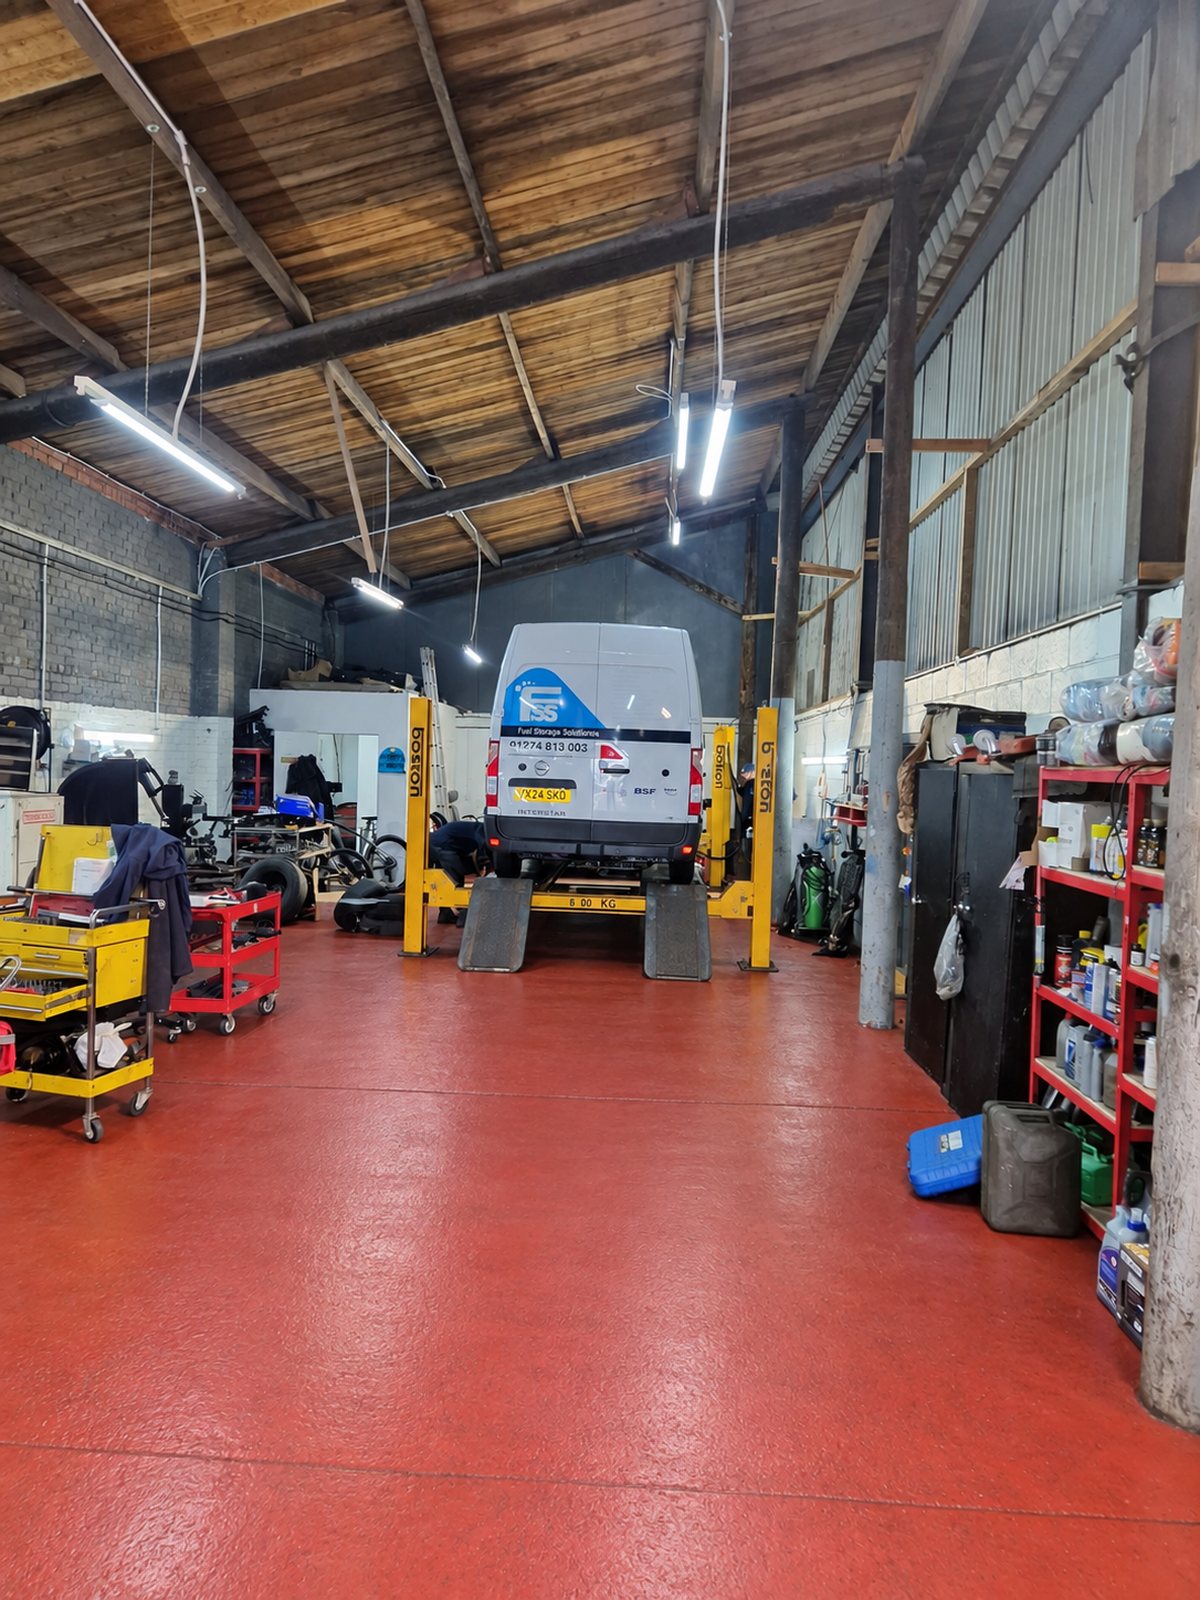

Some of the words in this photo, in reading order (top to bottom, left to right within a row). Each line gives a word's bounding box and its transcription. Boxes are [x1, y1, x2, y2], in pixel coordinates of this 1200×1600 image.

[517, 727, 532, 735] Fuel
[533, 728, 560, 737] Storage
[509, 740, 542, 750] 01274
[545, 741, 565, 752] 813
[567, 742, 588, 752] 003
[634, 787, 656, 795] BSF
[600, 899, 616, 908] KG
